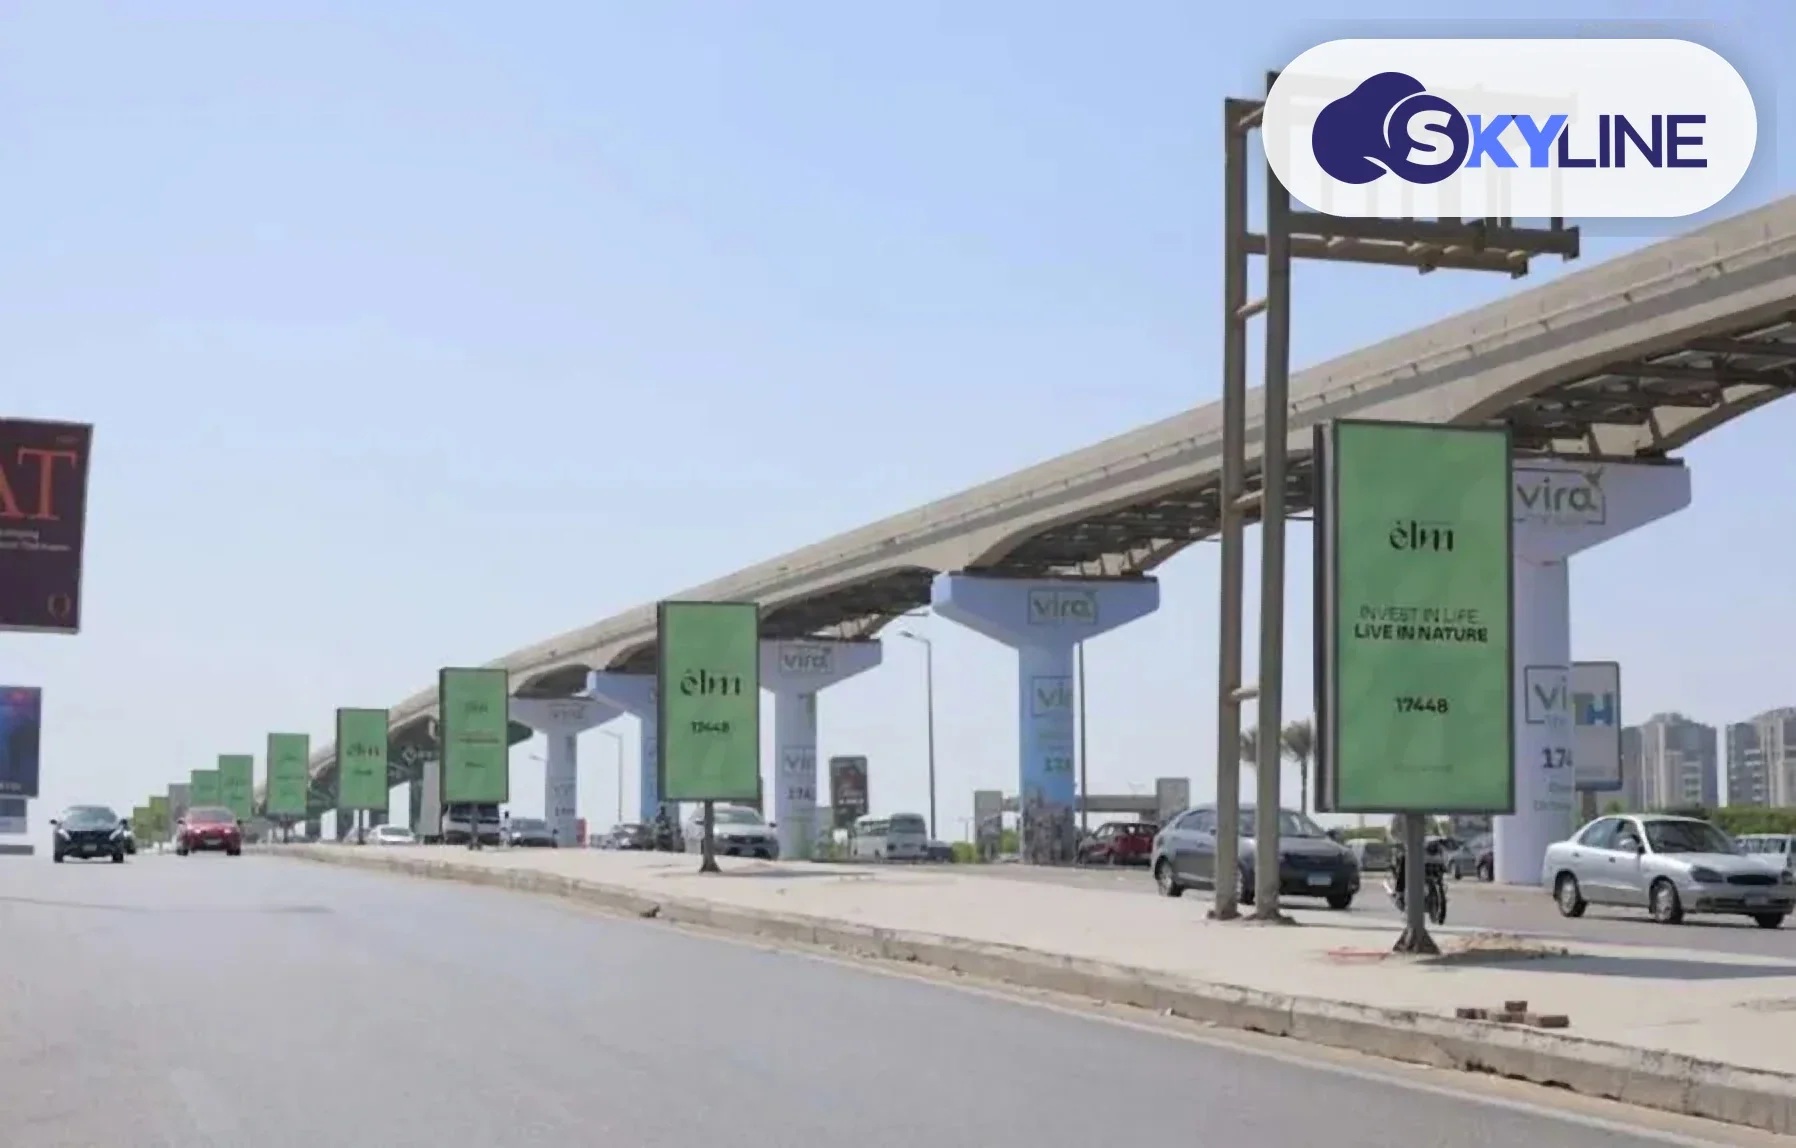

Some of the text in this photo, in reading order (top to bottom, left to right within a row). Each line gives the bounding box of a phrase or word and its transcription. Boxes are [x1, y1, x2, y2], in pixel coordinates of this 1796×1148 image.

[1516, 475, 1599, 513] vira
[1360, 604, 1481, 625] INVEST IN LIFE
[1354, 624, 1489, 643] LIVE IN NATURE
[1395, 696, 1449, 714] 17448
